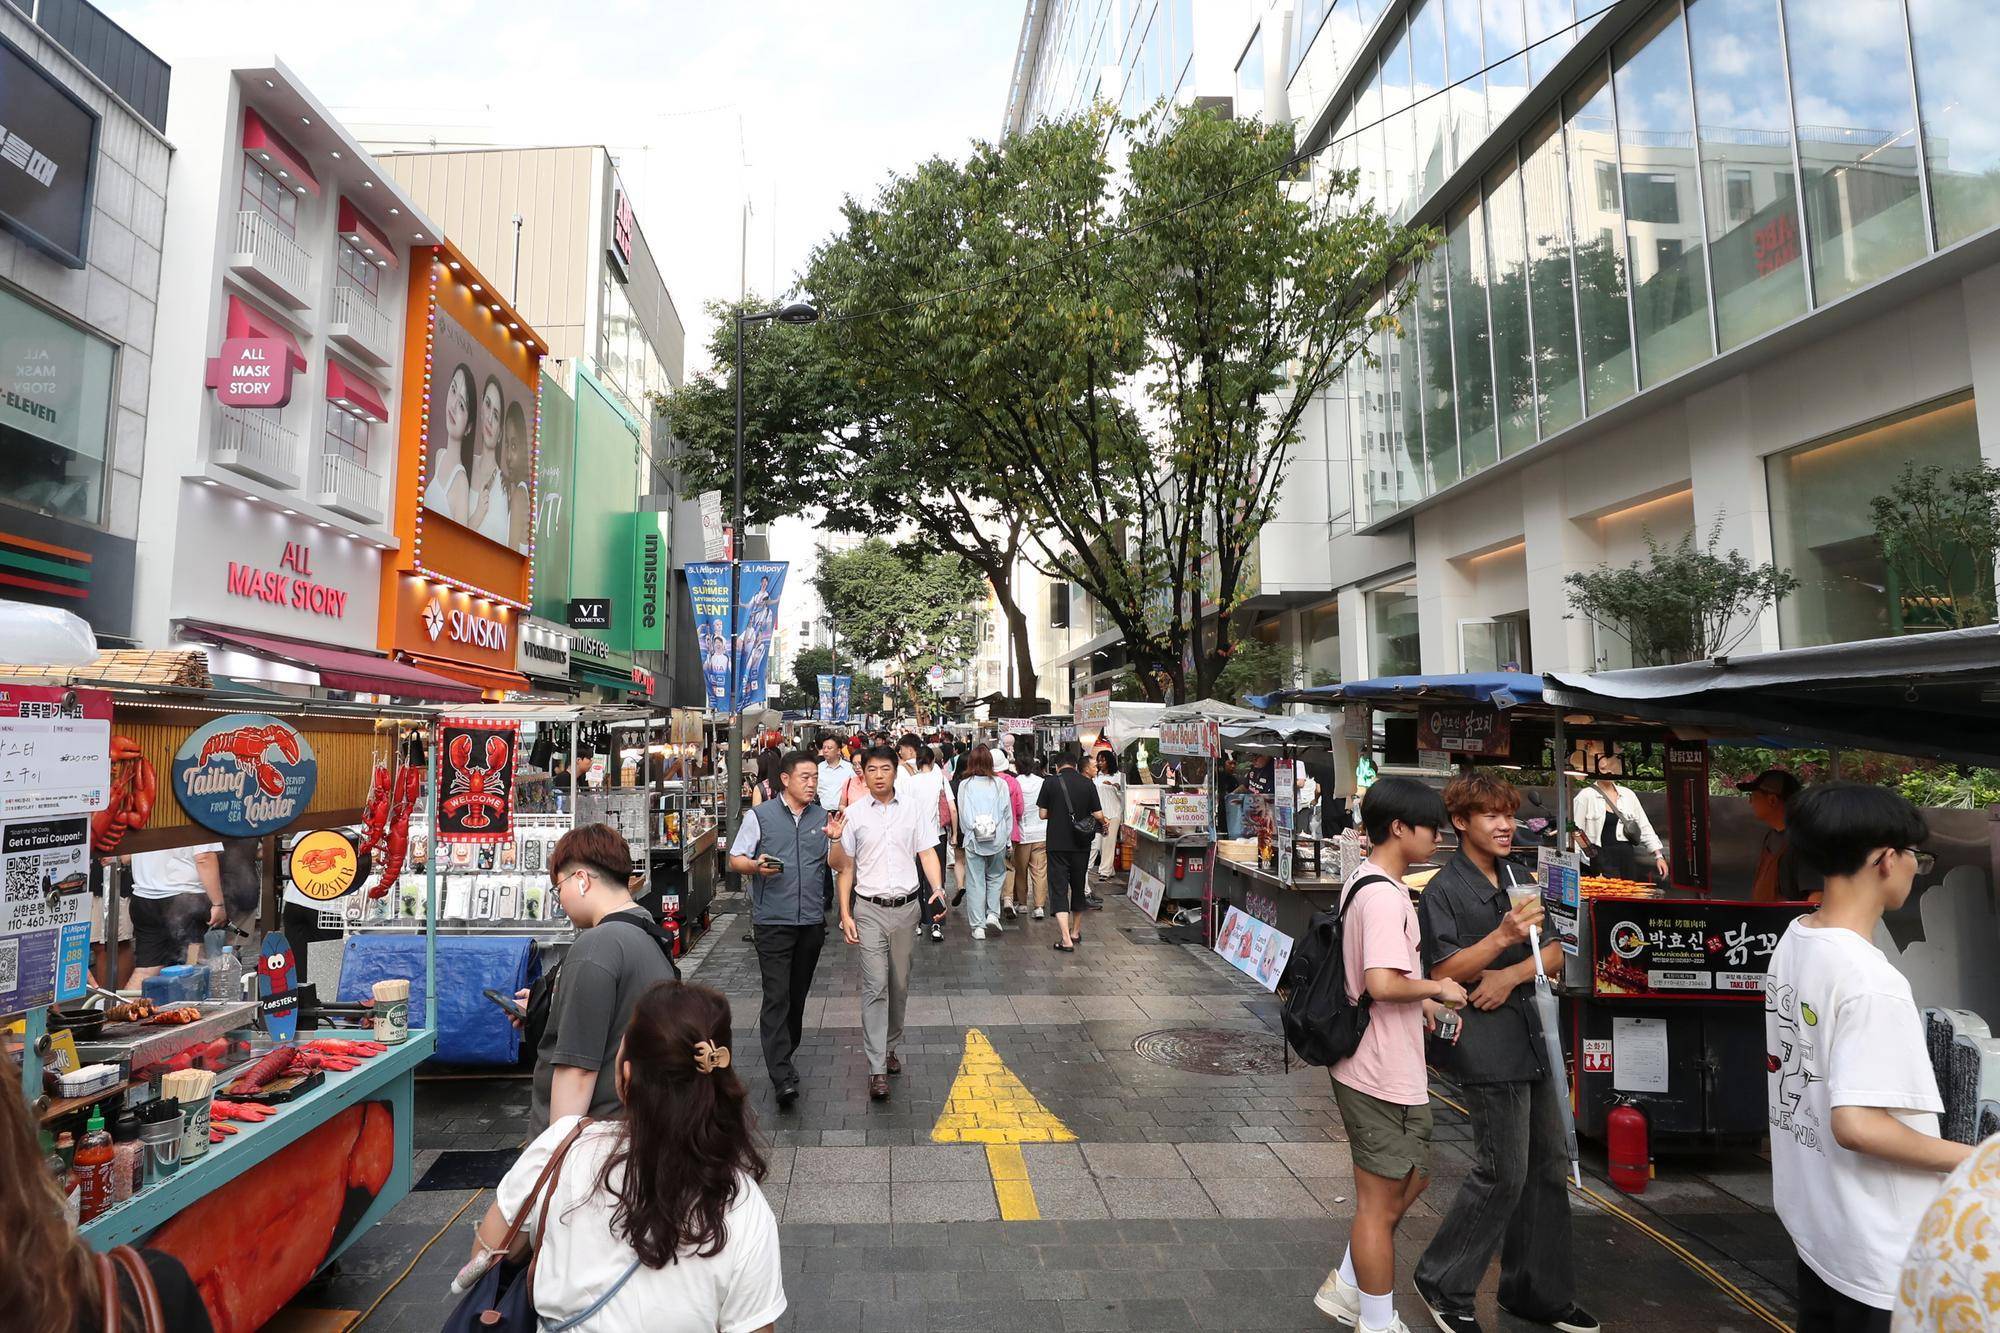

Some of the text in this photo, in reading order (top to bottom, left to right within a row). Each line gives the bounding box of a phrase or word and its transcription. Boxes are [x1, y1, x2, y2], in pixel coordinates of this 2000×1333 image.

[241, 348, 265, 360] ALL
[232, 365, 271, 377] MASK
[229, 382, 271, 394] STORY
[280, 541, 313, 576] ALL
[227, 561, 349, 619] MASK STORY
[692, 586, 729, 596] SUMMER
[579, 604, 602, 618] VT
[695, 603, 729, 616] EVENT
[450, 610, 507, 652] SUNSKIN
[19, 702, 51, 719] 품목별
[183, 765, 246, 799] Tailing
[285, 775, 306, 786] SERVED
[209, 799, 242, 813] FROM THE
[450, 794, 502, 808] WELCOME
[228, 810, 242, 822] SEA
[243, 792, 297, 829] Lobster
[9, 838, 24, 848] Get
[32, 834, 49, 845] Taxi
[304, 867, 355, 897] LOBSTER
[13, 902, 46, 919] 신한은행
[8, 911, 77, 932] 110-460-793371
[1648, 929, 1705, 952] 박효신
[1730, 981, 1759, 989] TAKE OUT
[264, 996, 293, 1010] LOBSTER
[1585, 1041, 1608, 1051] 소화기
